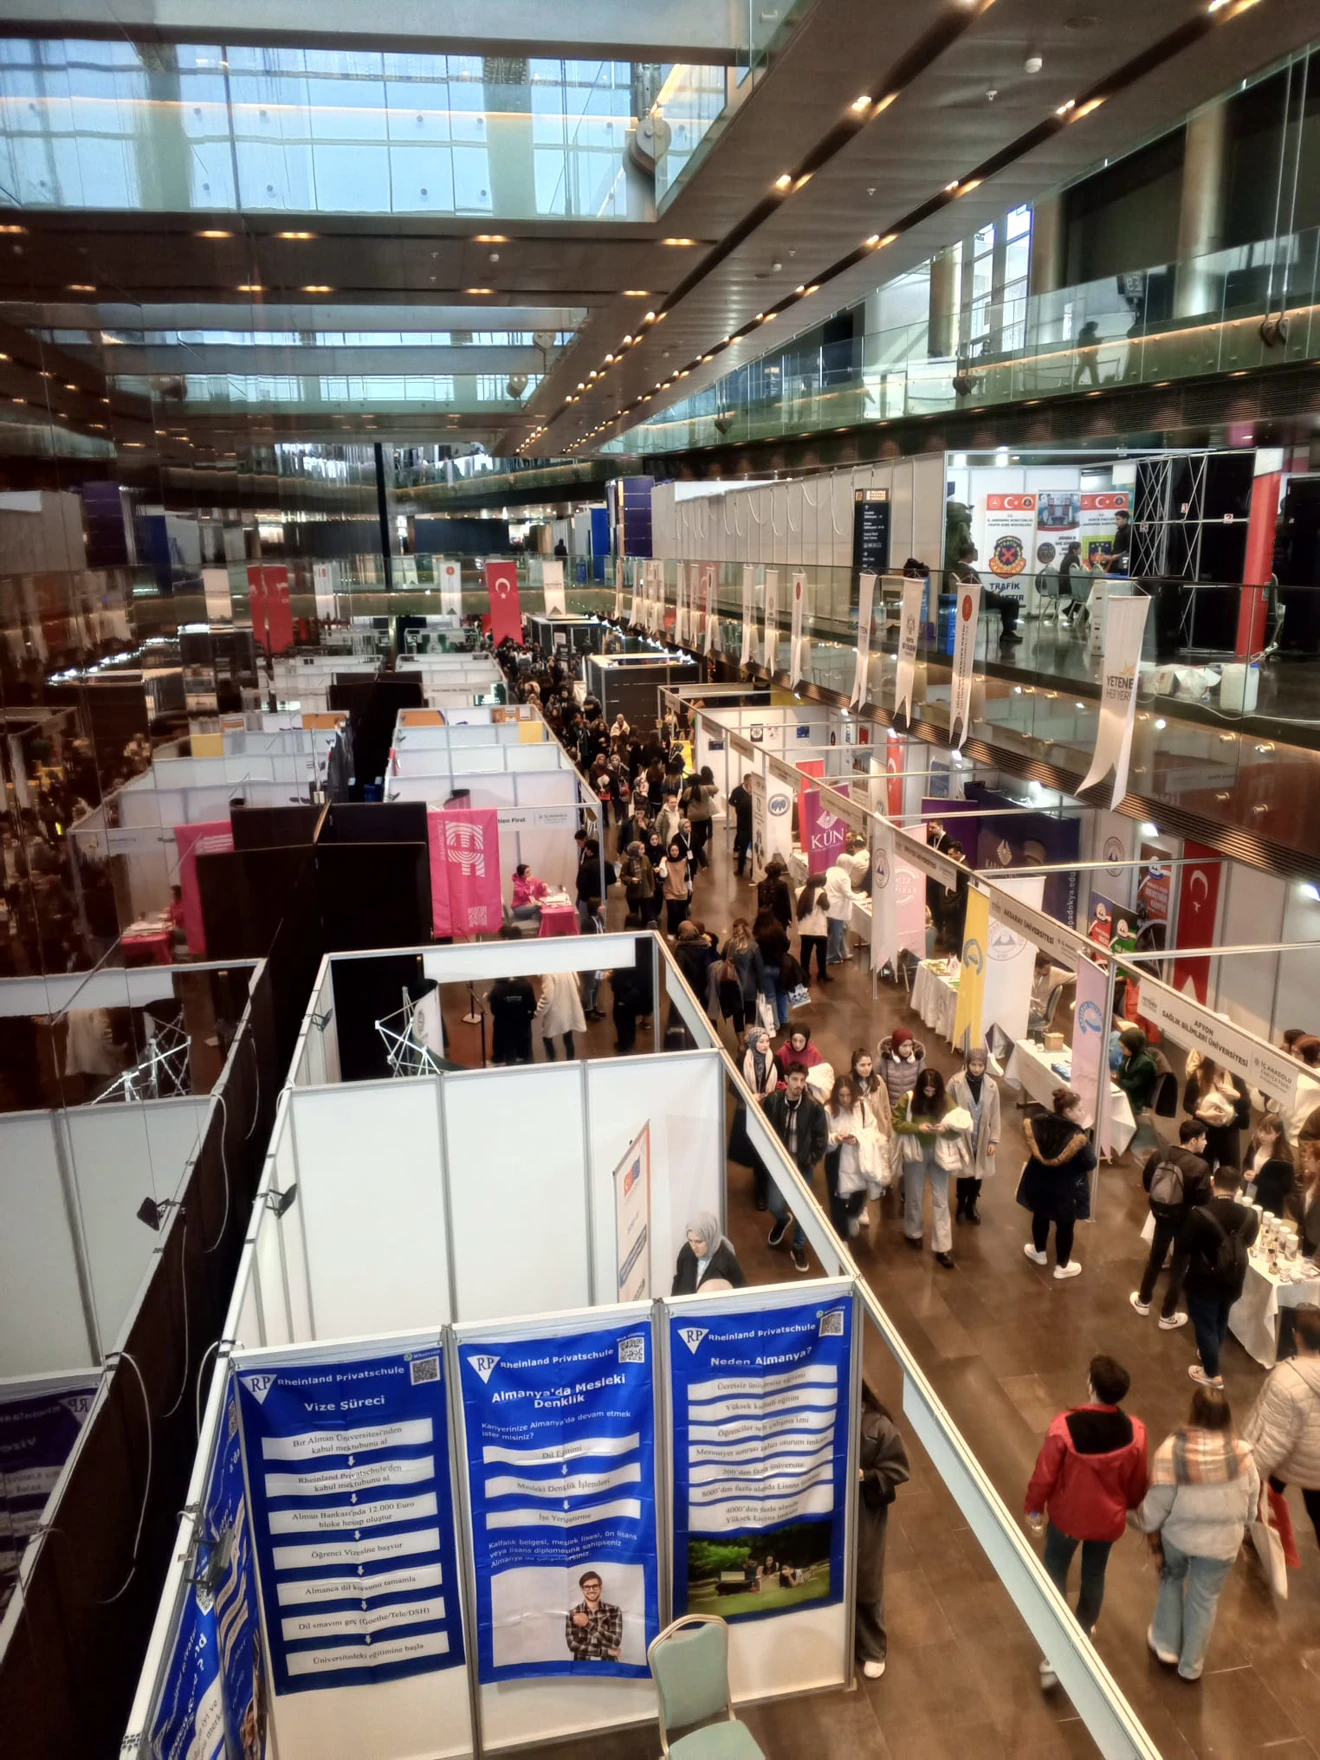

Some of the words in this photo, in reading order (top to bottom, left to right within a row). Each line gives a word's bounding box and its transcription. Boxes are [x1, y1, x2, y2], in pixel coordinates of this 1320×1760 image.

[989, 580, 1020, 590] TRAFİK
[811, 828, 844, 850] KÜN
[1208, 1037, 1248, 1068] ÜNİVERSİTESİ
[686, 1330, 703, 1344] RP
[708, 1330, 755, 1342] Rheinland
[758, 1323, 816, 1337] Privatschule
[476, 1356, 495, 1372] RP
[500, 1357, 550, 1369] Rheinland
[552, 1348, 614, 1364] Privatschule
[710, 1357, 750, 1366] Neden
[755, 1346, 813, 1366] Almanya?
[250, 1376, 271, 1392] RP
[277, 1375, 332, 1386] Rheinland
[336, 1366, 405, 1382] Privatschule
[492, 1386, 571, 1403] Almanya'da
[575, 1374, 626, 1393] Mesleki
[304, 1400, 336, 1412] Vize
[340, 1394, 385, 1410] Süreci
[534, 1394, 585, 1408] Denklik
[482, 1422, 528, 1433] Kariyerinize
[530, 1416, 576, 1429] Almanya'da
[577, 1410, 604, 1421] devam
[606, 1410, 631, 1418] etmek
[307, 1435, 334, 1445] Alman
[502, 1432, 534, 1441] misiniz?
[311, 1445, 334, 1454] kabul
[542, 1451, 554, 1459] Dil
[298, 1474, 338, 1484] Rheinland
[314, 1483, 334, 1492] kabul
[292, 1512, 318, 1521] Alman
[369, 1504, 394, 1513] 12.000
[396, 1501, 415, 1510] Euro
[319, 1520, 340, 1528] bloke
[298, 1622, 310, 1630] Dil
